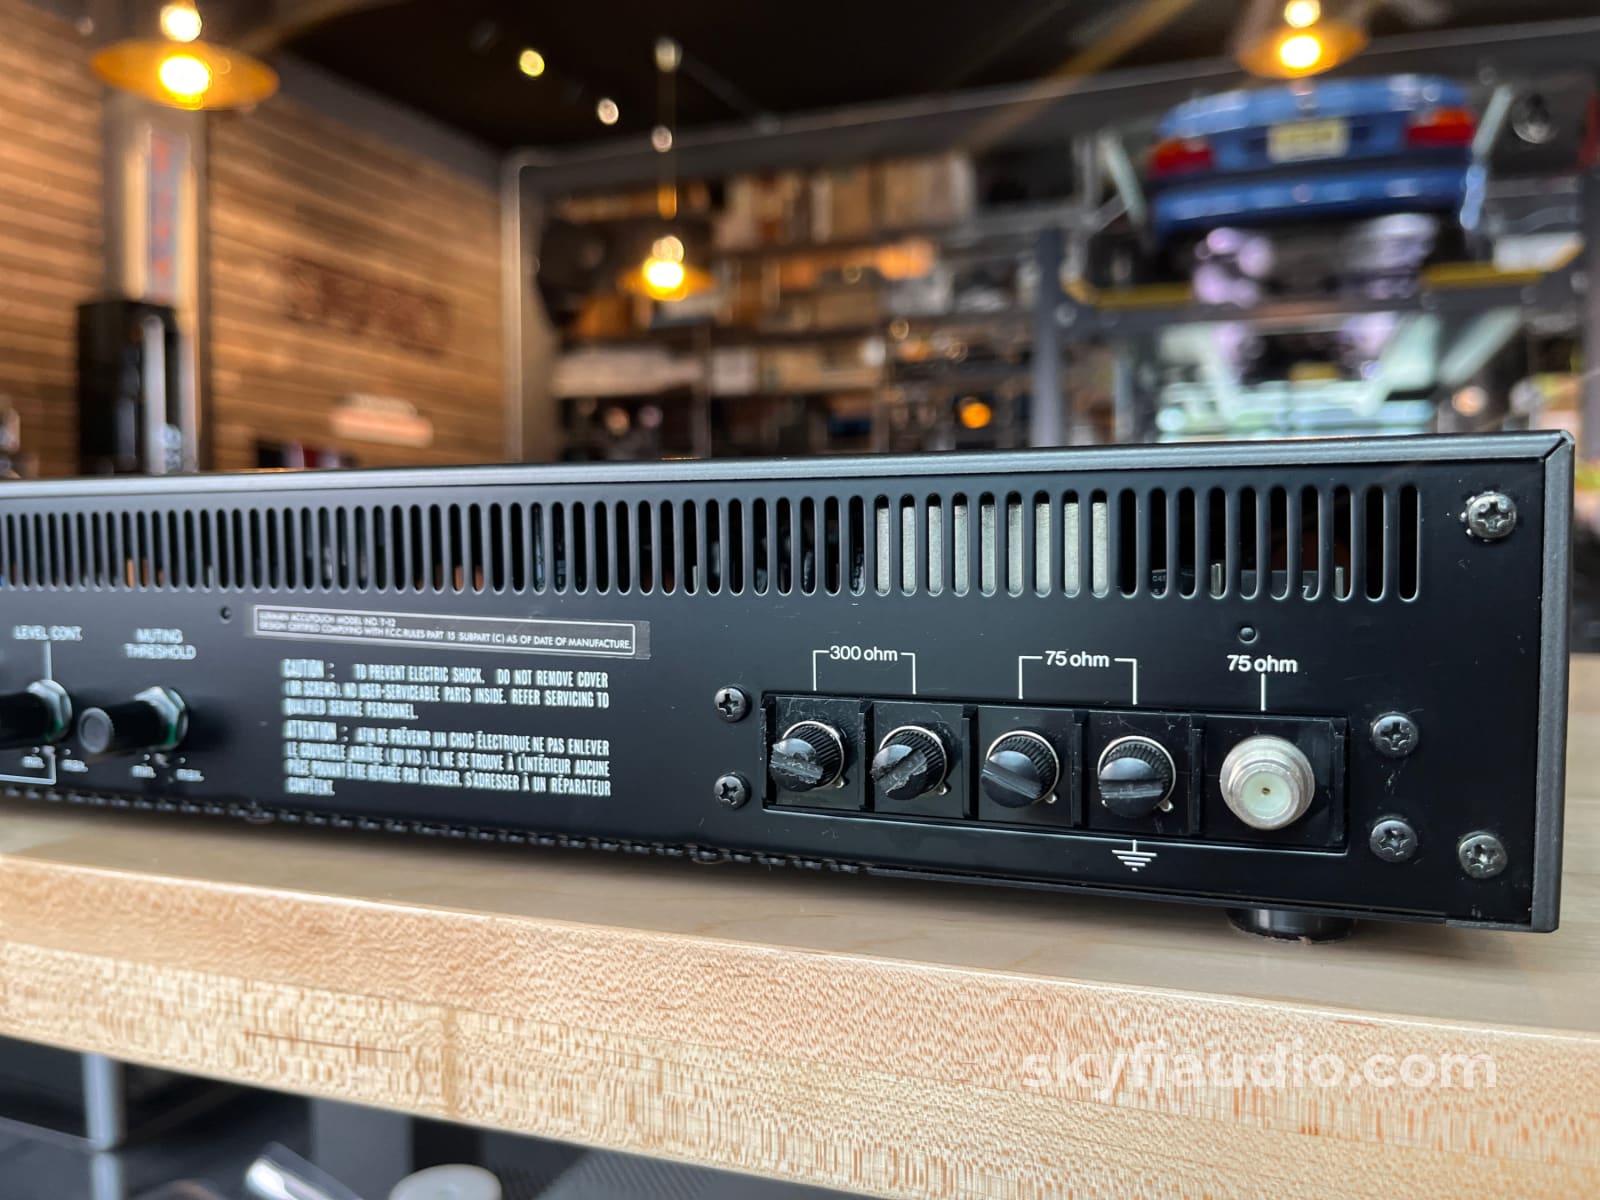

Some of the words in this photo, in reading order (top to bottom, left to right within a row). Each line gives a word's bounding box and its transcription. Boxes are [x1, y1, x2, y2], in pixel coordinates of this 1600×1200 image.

[336, 615, 362, 625] MODEL
[13, 625, 48, 640] LEVEL
[135, 628, 183, 644] MUTING
[426, 630, 444, 641] PART
[447, 631, 456, 641] 15
[459, 631, 491, 643] SUBPART
[492, 633, 505, 645] (C)
[506, 634, 517, 645] AS
[520, 634, 532, 645] OF
[534, 635, 553, 647] DATE
[555, 636, 567, 647] OF
[568, 637, 632, 650] MANUFACTURE.
[123, 642, 197, 660] THRESHOLD
[829, 645, 861, 661] 300
[863, 647, 898, 662] ohm
[1045, 649, 1067, 666] 75
[1069, 650, 1110, 668] ohm
[1226, 654, 1252, 672] 75
[1253, 654, 1298, 673] ohm
[367, 664, 406, 681] PREVENT
[407, 665, 449, 683] ELECTRIC
[452, 667, 485, 684] SHOCK.
[496, 669, 510, 685] DO
[513, 670, 533, 686] NOT
[536, 670, 574, 687] REMOVE
[577, 672, 609, 688] COVER
[443, 686, 471, 703] PARTS
[474, 688, 507, 705] INSIDE.
[511, 689, 540, 705] REFER
[544, 690, 594, 708] SERVICING
[596, 692, 609, 708] TO
[327, 699, 364, 717] SERVICE
[365, 701, 419, 720] PERSONNEL.
[431, 732, 447, 748] UN
[449, 732, 475, 749] CHOC
[475, 731, 530, 753] ÉLECTRIQUE
[531, 736, 545, 752] NE
[547, 737, 565, 754] PAS
[567, 738, 610, 756] ENLEVER
[441, 752, 455, 768] NE
[456, 752, 470, 768] SE
[470, 753, 504, 771] TROUVE
[516, 754, 571, 775] L'INTÉRIEUR
[574, 760, 610, 777] AUCUNE
[464, 770, 519, 791] S'ADRESSER
[532, 776, 546, 792] UN
[550, 774, 611, 796] RÉPARATEUR
